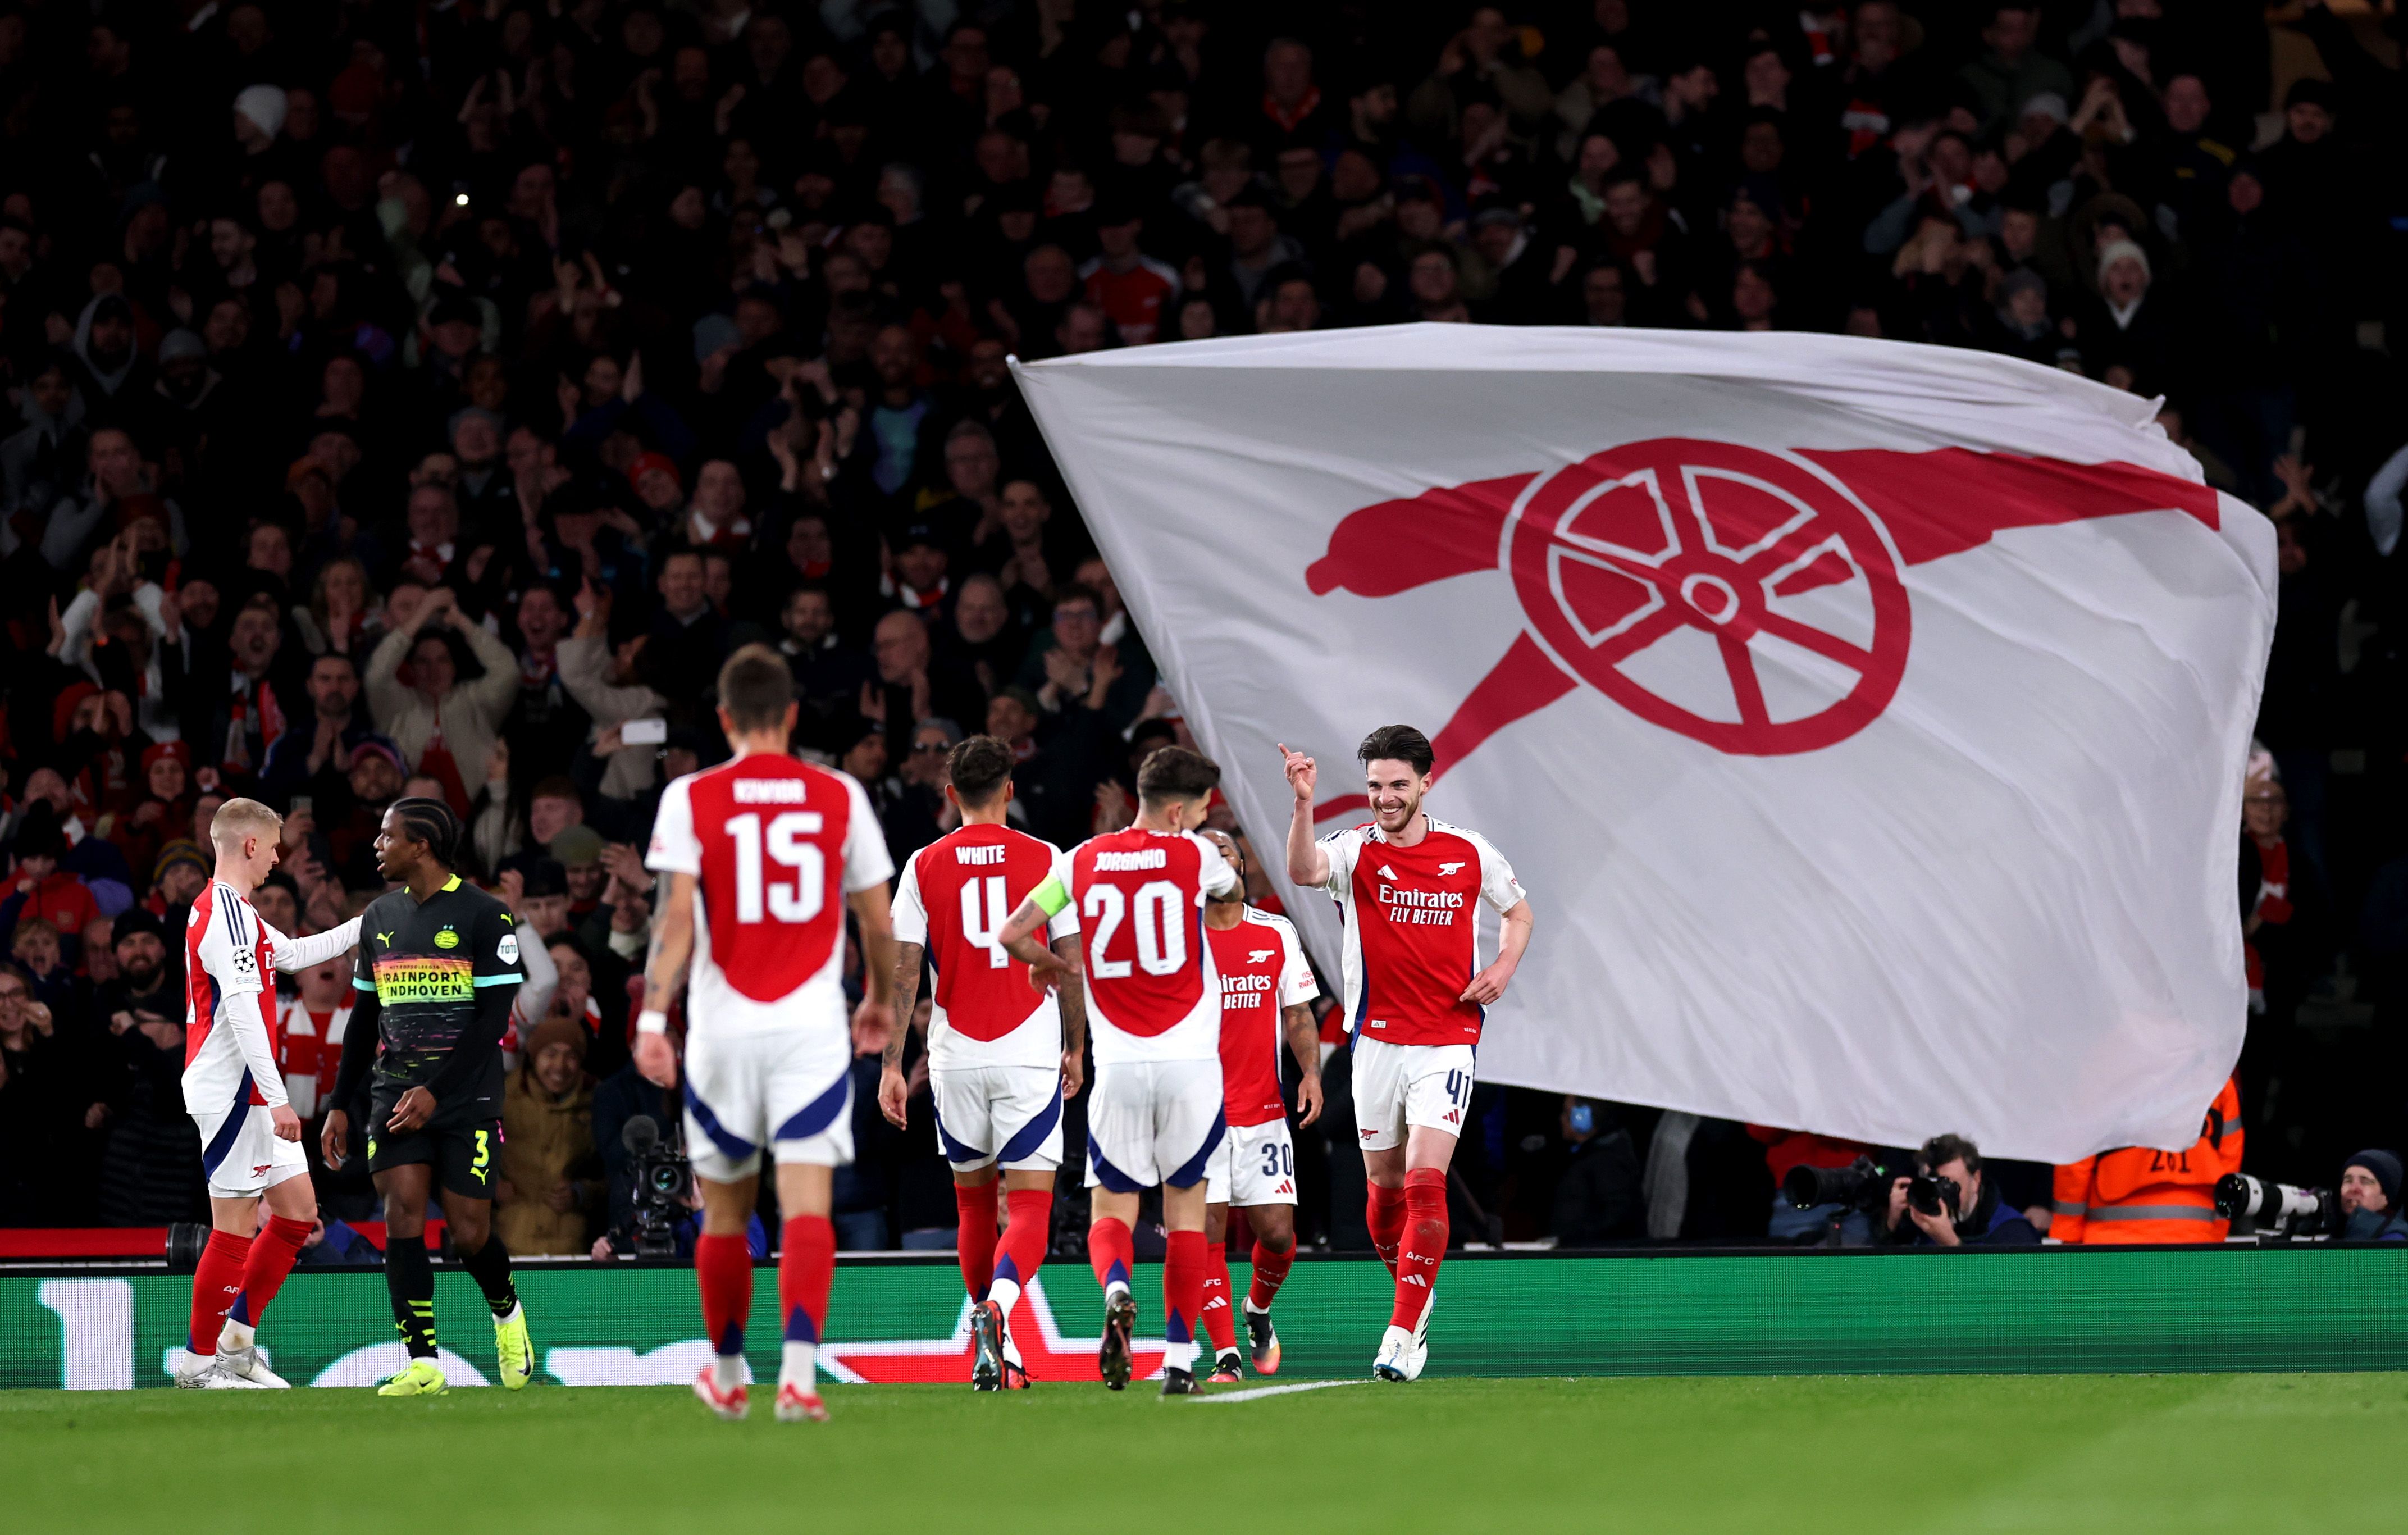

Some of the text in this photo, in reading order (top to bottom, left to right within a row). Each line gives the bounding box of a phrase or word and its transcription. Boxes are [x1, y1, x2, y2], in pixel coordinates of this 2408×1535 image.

[955, 845, 1005, 865] WHITE
[1093, 848, 1166, 872] JORGINHO
[725, 812, 824, 923] 15
[1379, 883, 1463, 908] Emirates
[960, 876, 1009, 969] 4
[1389, 907, 1453, 926] FLY BETTER
[1084, 880, 1187, 979] 20
[383, 972, 459, 983] RAINPORT
[1219, 973, 1271, 992] irates
[1224, 992, 1261, 1009] BETTER
[1445, 1068, 1470, 1110] 41
[473, 1129, 489, 1167] 3
[1261, 1142, 1292, 1176] 30
[1406, 1251, 1435, 1265] AFC
[223, 1285, 240, 1294] AF
